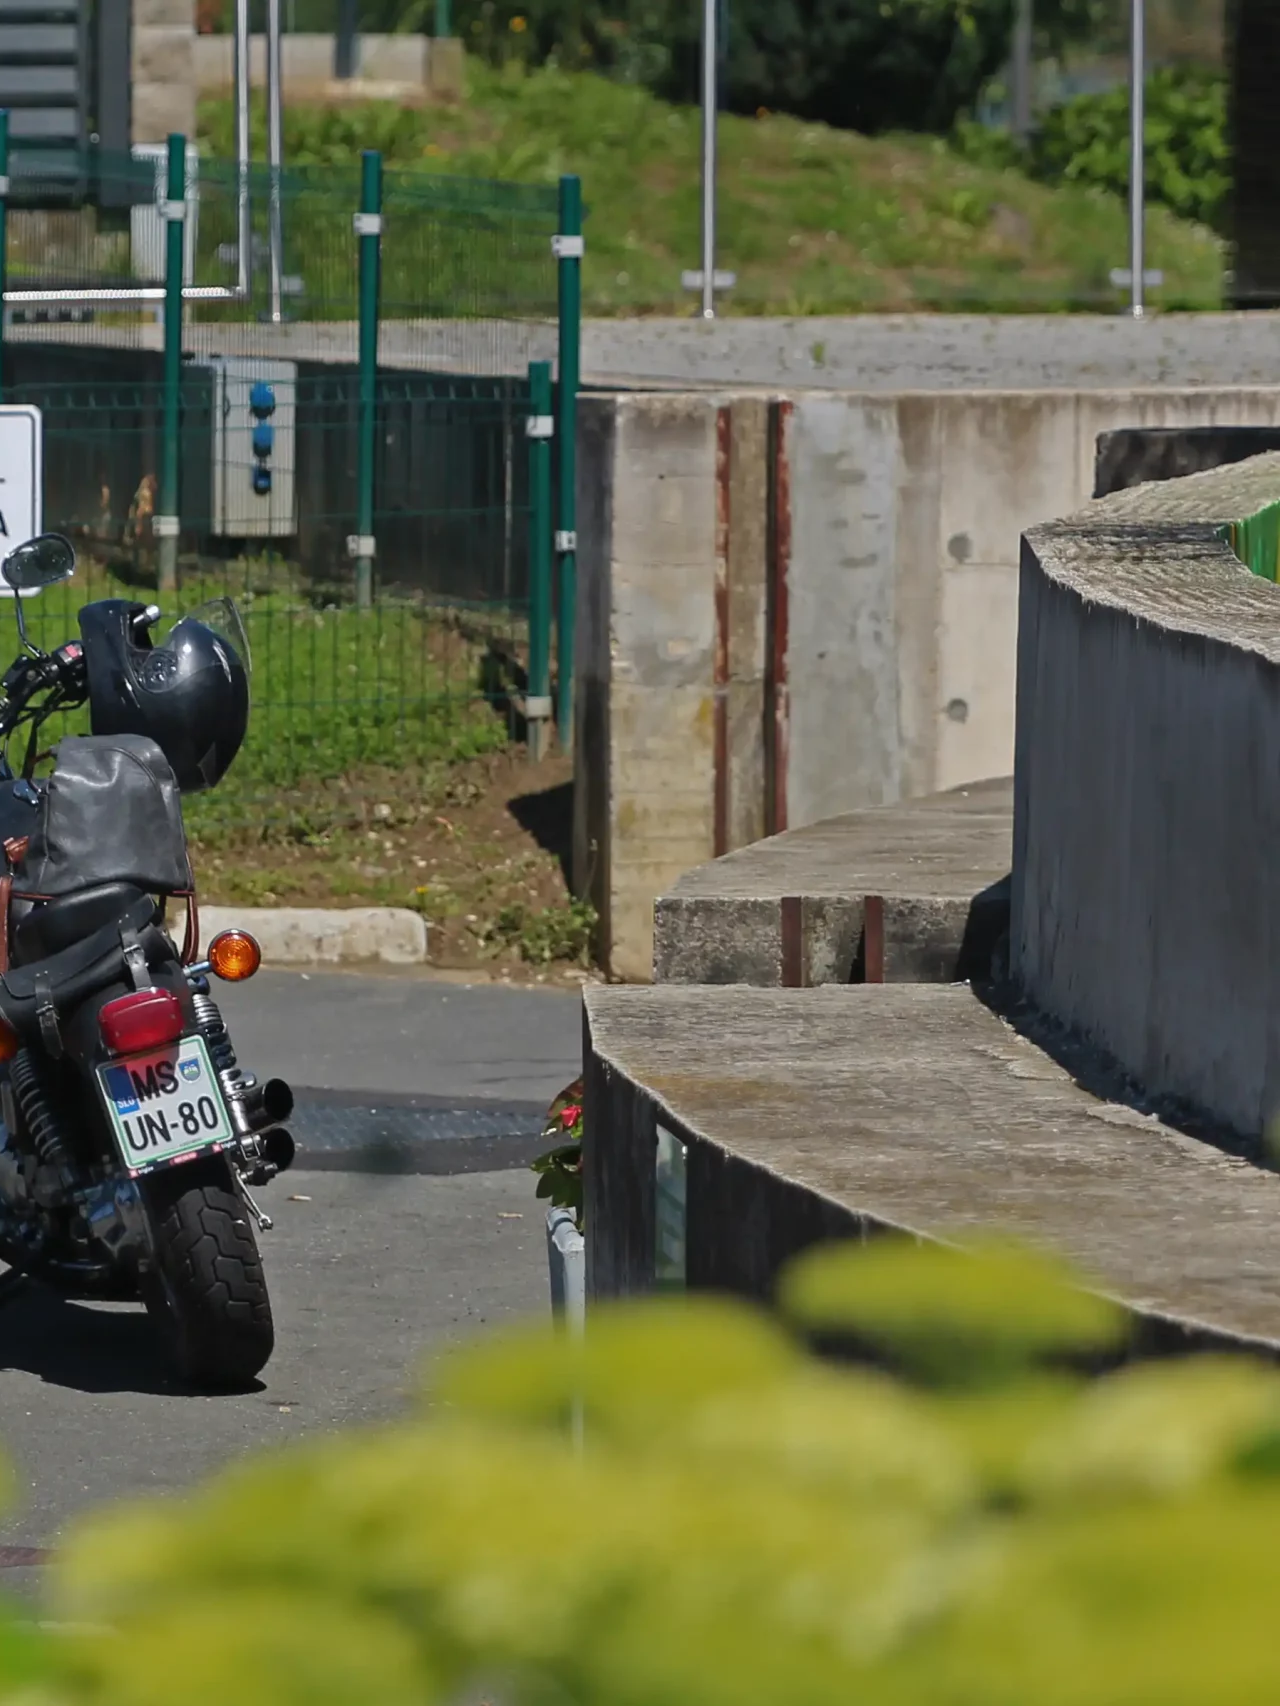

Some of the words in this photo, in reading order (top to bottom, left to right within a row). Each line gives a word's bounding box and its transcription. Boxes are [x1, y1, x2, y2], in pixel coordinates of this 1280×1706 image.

[117, 1096, 135, 1108] SLO
[130, 1060, 179, 1102] MS
[122, 1096, 218, 1150] UN-80
